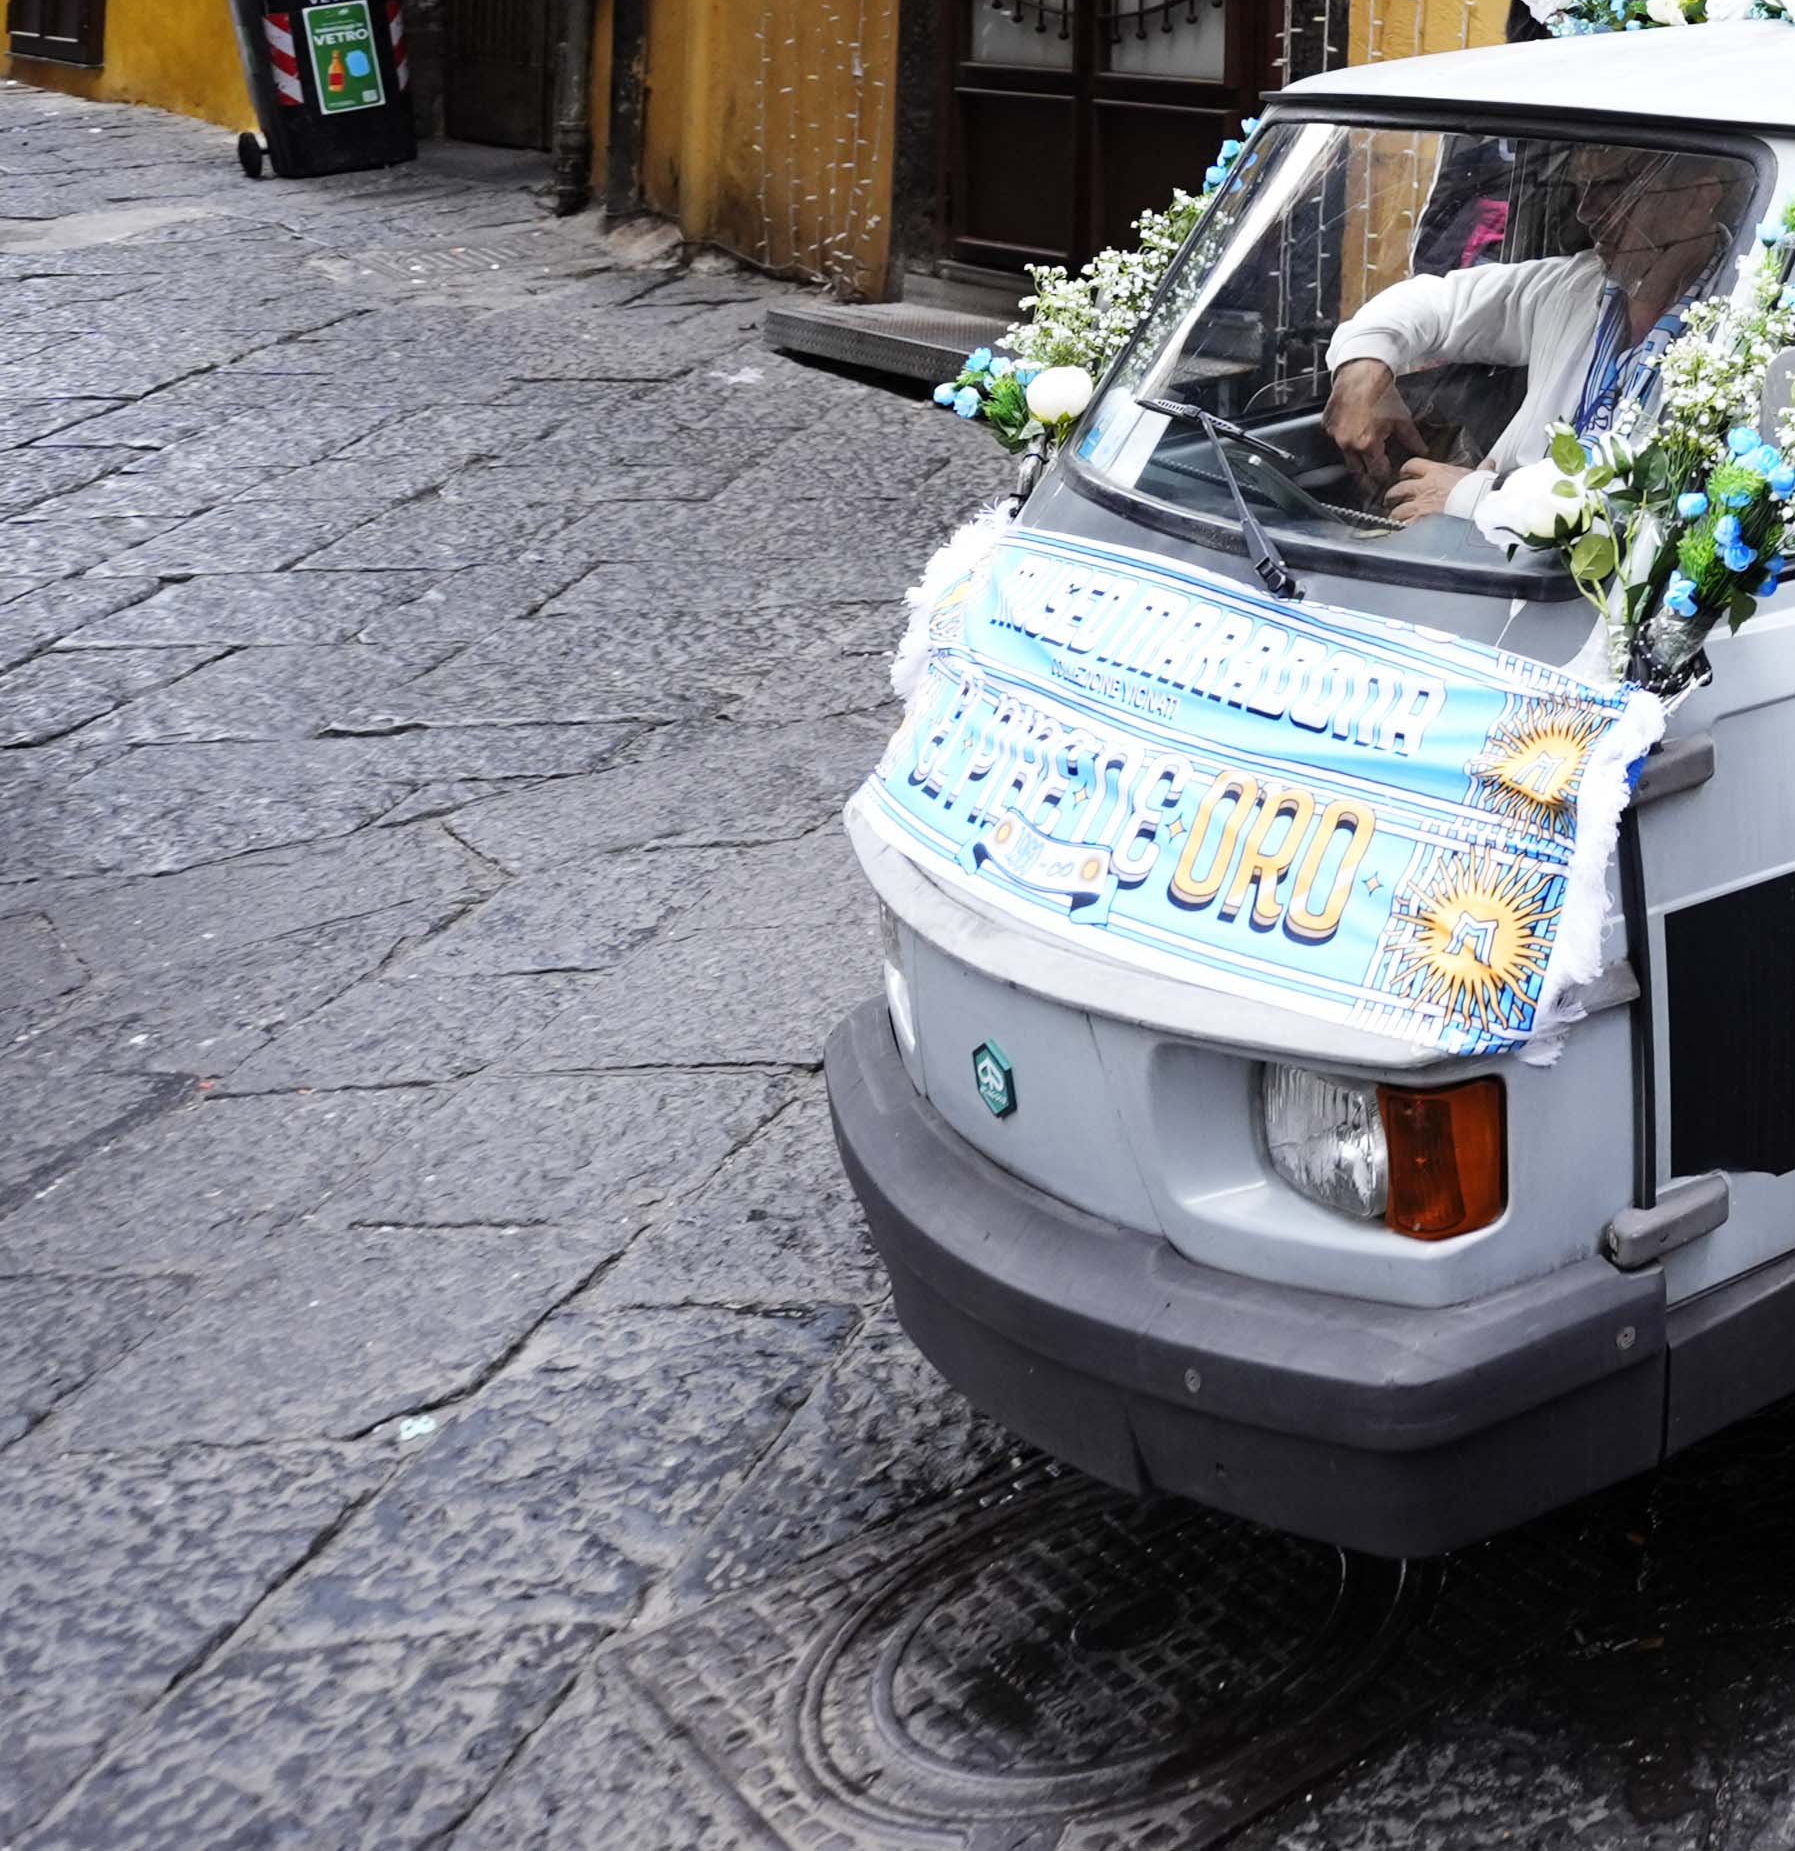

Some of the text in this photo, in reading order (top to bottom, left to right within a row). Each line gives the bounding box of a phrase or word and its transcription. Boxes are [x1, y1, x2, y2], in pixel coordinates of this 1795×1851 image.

[312, 28, 370, 47] VETRO
[1096, 578, 1449, 758] MARADONA
[1166, 769, 1377, 947] ORO
